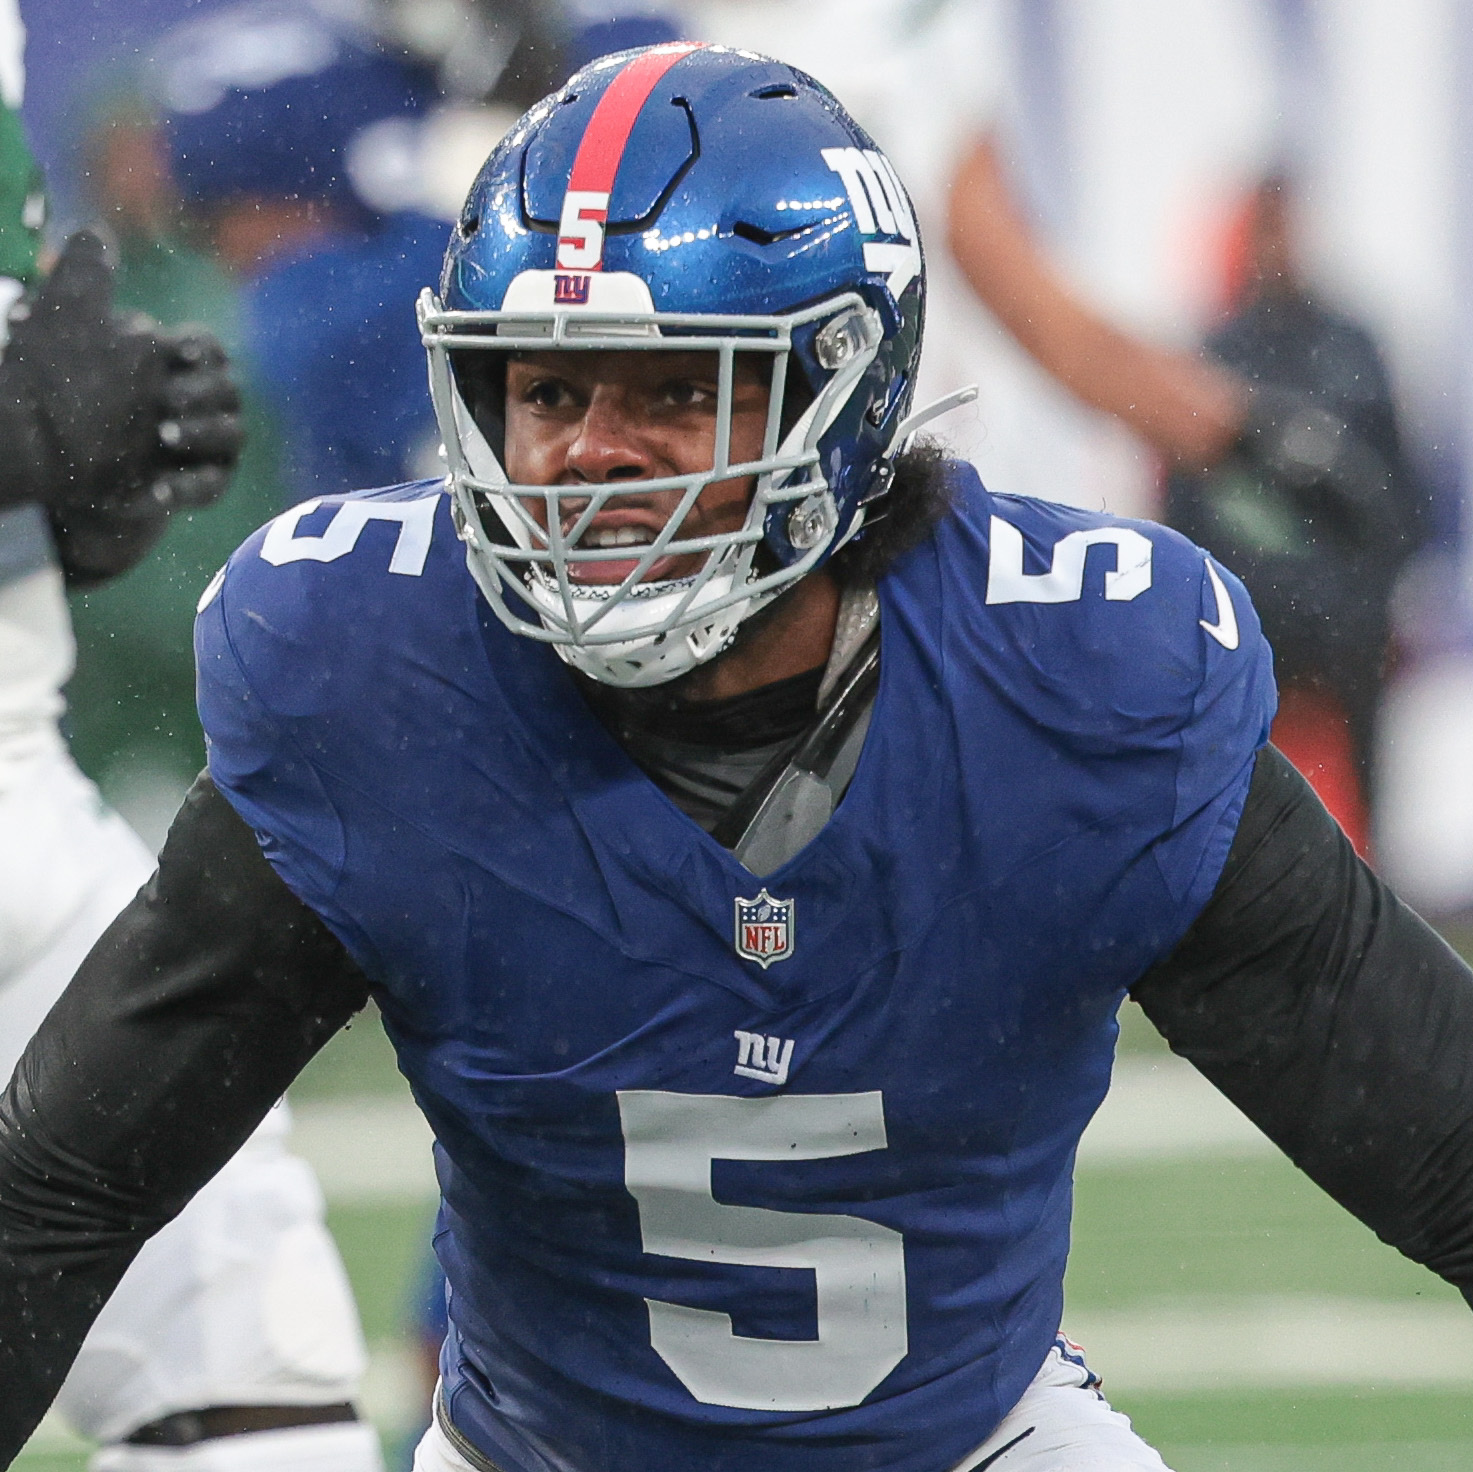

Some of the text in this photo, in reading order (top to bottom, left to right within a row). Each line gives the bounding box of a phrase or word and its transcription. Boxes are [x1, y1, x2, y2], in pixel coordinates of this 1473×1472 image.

[557, 190, 610, 268] 5
[259, 492, 442, 577] 5
[985, 513, 1153, 605] 5
[744, 925, 785, 954] NFL
[616, 1090, 908, 1412] 5
